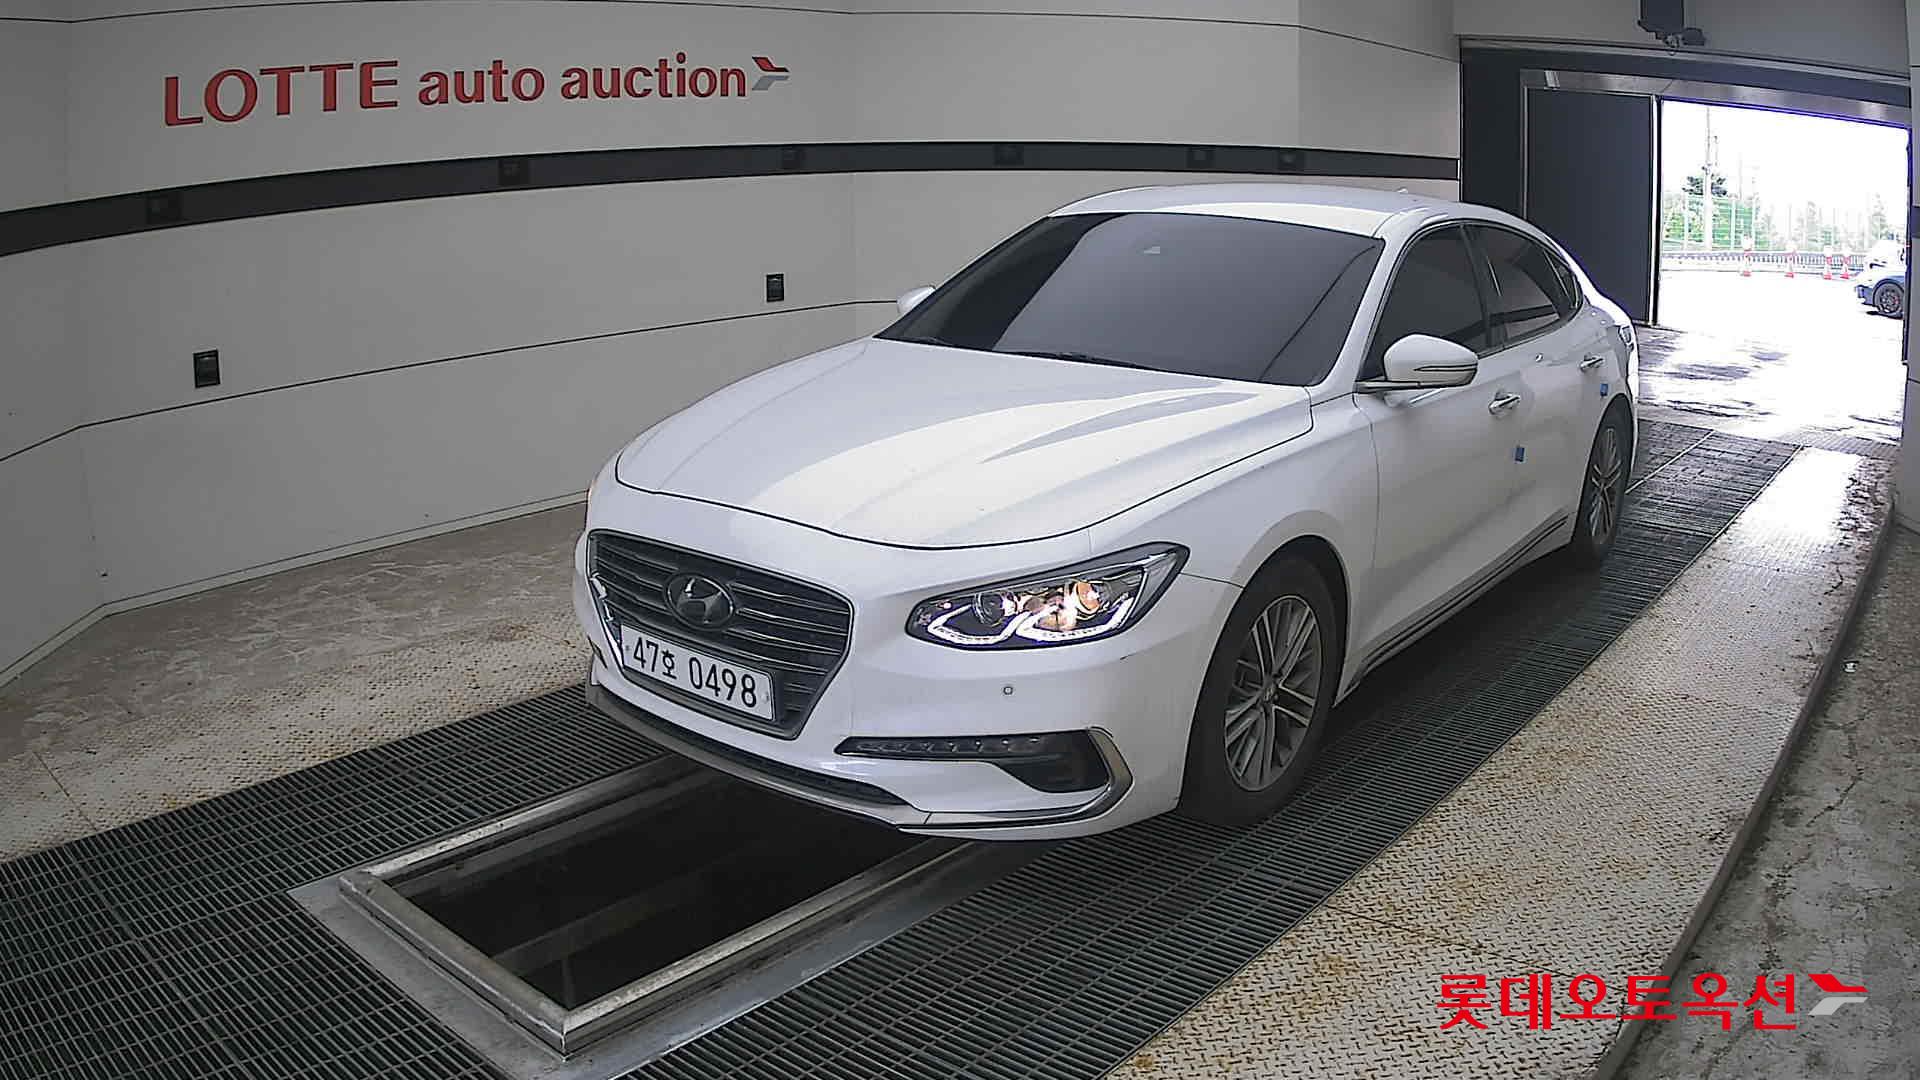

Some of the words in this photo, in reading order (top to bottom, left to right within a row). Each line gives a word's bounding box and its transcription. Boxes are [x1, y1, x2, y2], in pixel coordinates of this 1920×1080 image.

[164, 60, 399, 127] LOTTE
[417, 58, 545, 105] auto
[560, 52, 747, 100] auction
[633, 637, 677, 680] 47호
[688, 656, 757, 708] 0498
